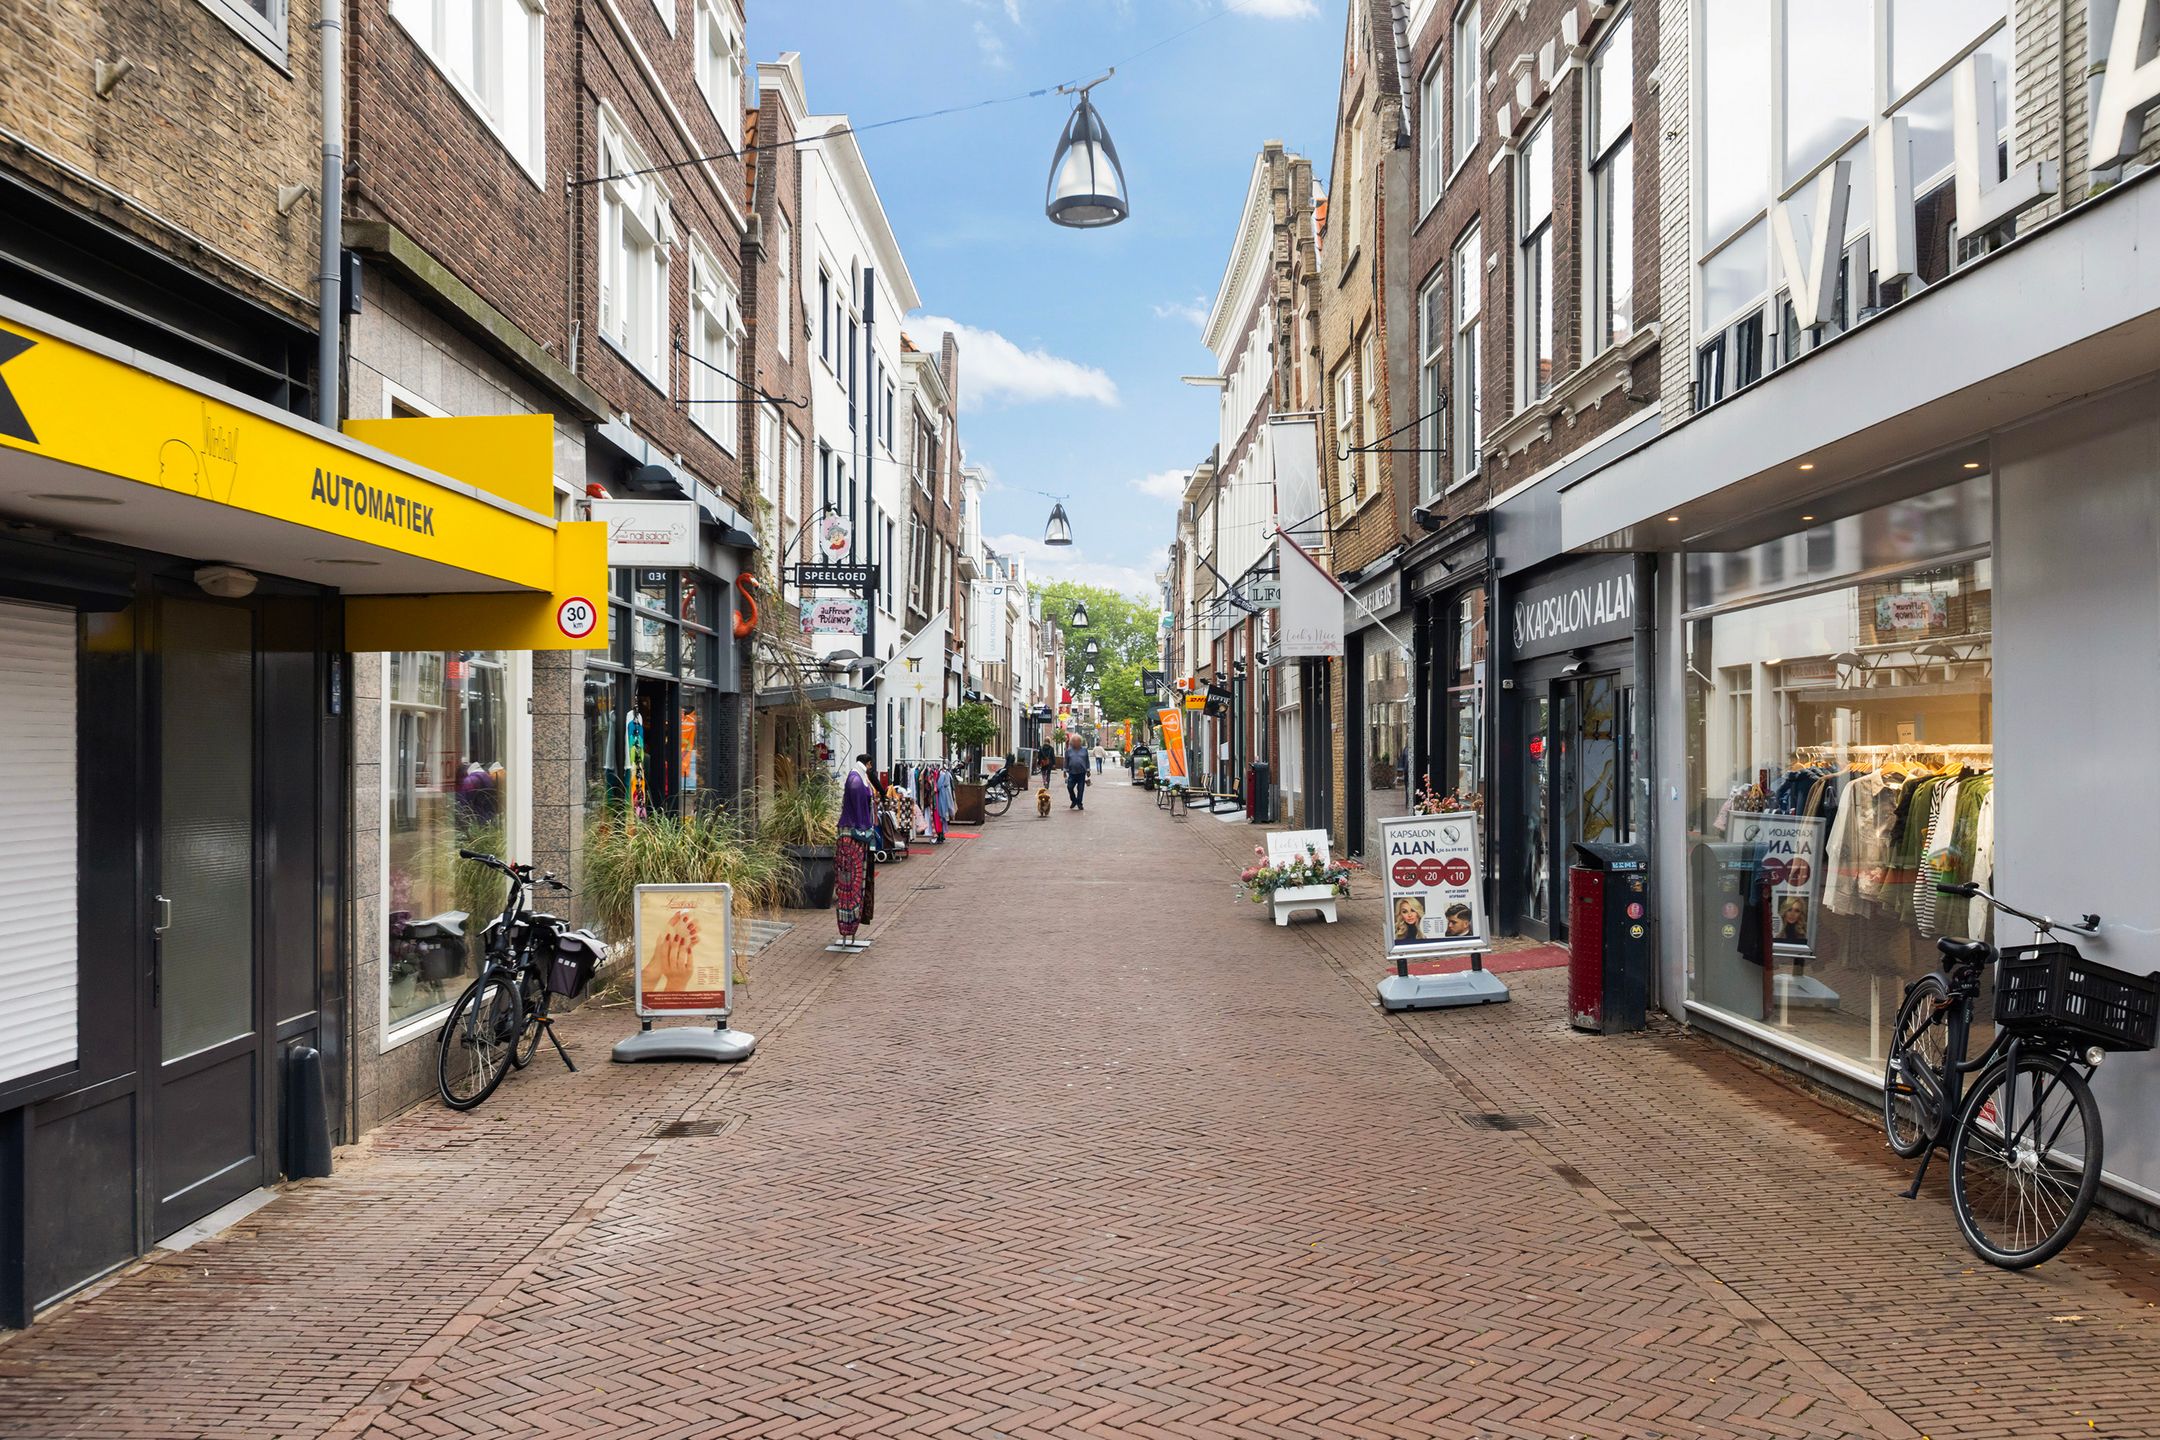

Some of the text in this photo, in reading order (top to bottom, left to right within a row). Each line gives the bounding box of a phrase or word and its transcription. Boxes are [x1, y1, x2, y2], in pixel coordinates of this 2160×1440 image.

[311, 467, 434, 537] AUTOMATIEK
[629, 531, 644, 540] nail
[646, 531, 668, 540] salon
[804, 571, 867, 581] SPEELGOED
[1526, 573, 1635, 642] KAPSALON ALAN
[567, 606, 586, 621] 30
[1390, 829, 1436, 839] KAPSALON
[1391, 841, 1436, 856] ALAN
[1424, 871, 1438, 881] €20
[1455, 871, 1465, 881] 10
